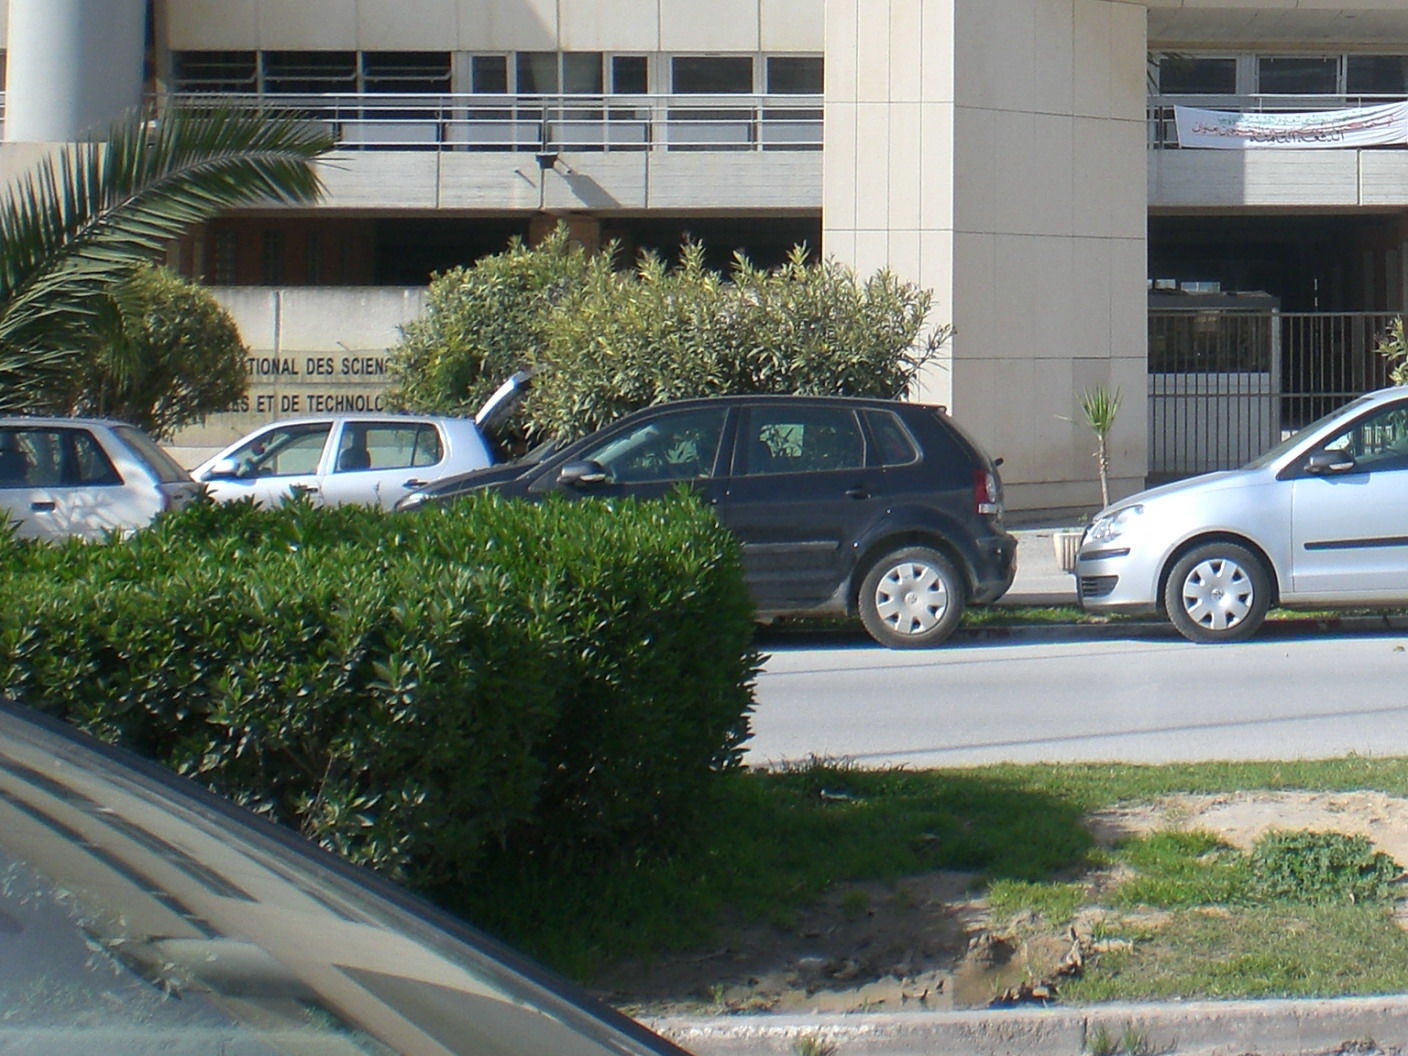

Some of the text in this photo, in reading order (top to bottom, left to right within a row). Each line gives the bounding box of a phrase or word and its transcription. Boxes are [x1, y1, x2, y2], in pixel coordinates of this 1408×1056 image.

[247, 357, 394, 375] TIONAL DES SCIENC
[257, 394, 274, 413] ET
[281, 394, 300, 413] DE
[306, 394, 384, 413] TECHNOLO
